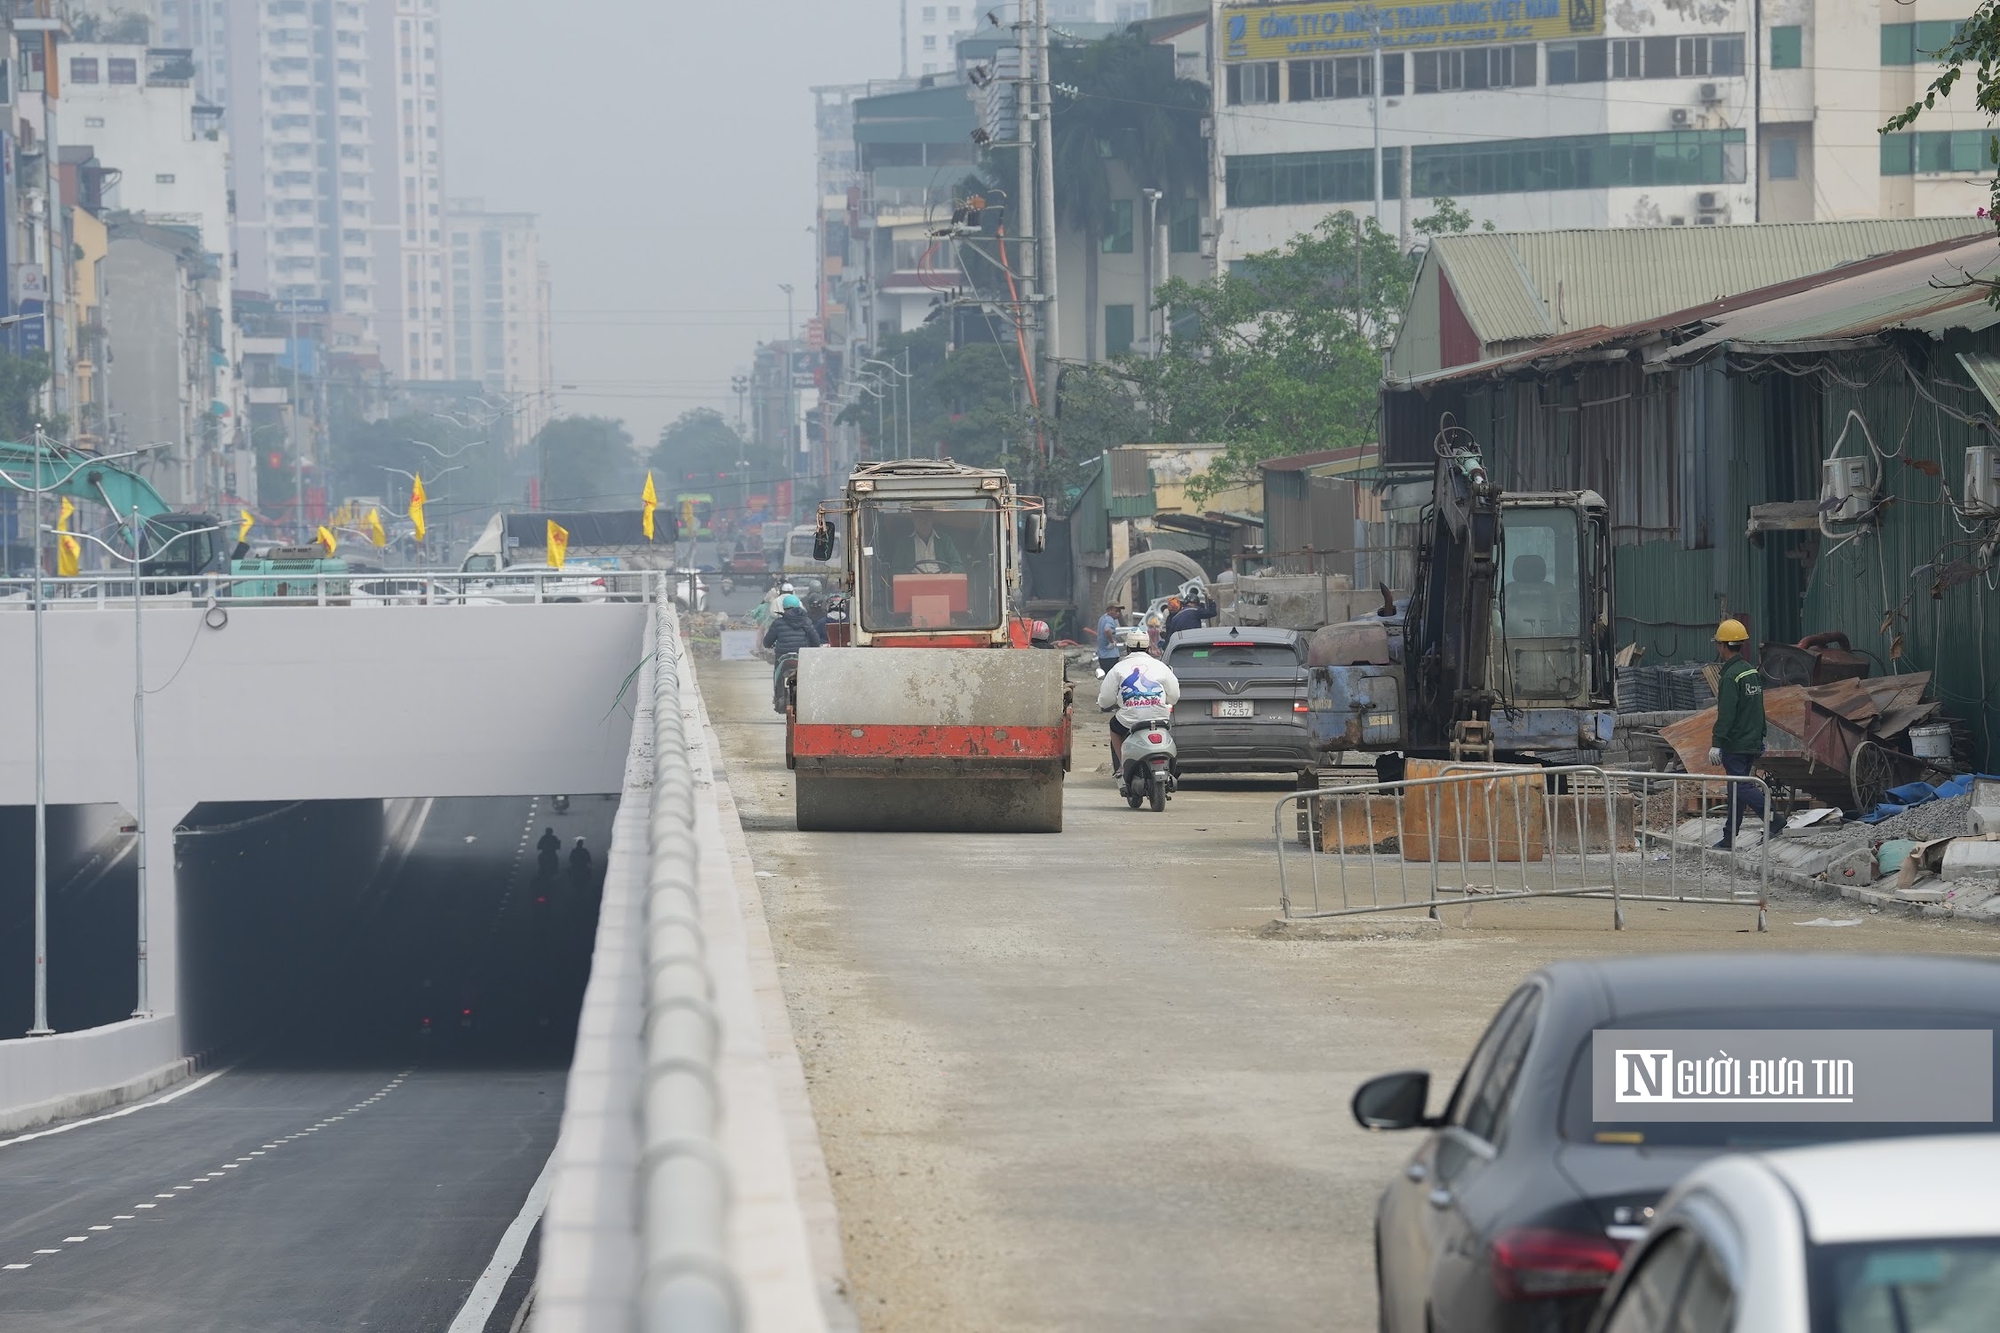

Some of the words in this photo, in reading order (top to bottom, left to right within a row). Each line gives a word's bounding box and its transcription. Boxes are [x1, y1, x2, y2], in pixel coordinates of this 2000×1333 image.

[1259, 10, 1299, 39] CÔNG
[1301, 13, 1319, 36] TY
[1321, 12, 1340, 34] CP
[1396, 5, 1445, 29] TRANG
[1525, 0, 1560, 19] NAM
[1287, 38, 1365, 53] VIETNAM
[1441, 28, 1498, 42] PAGES
[1227, 700, 1244, 708] 98B
[1223, 709, 1250, 717] 142.57
